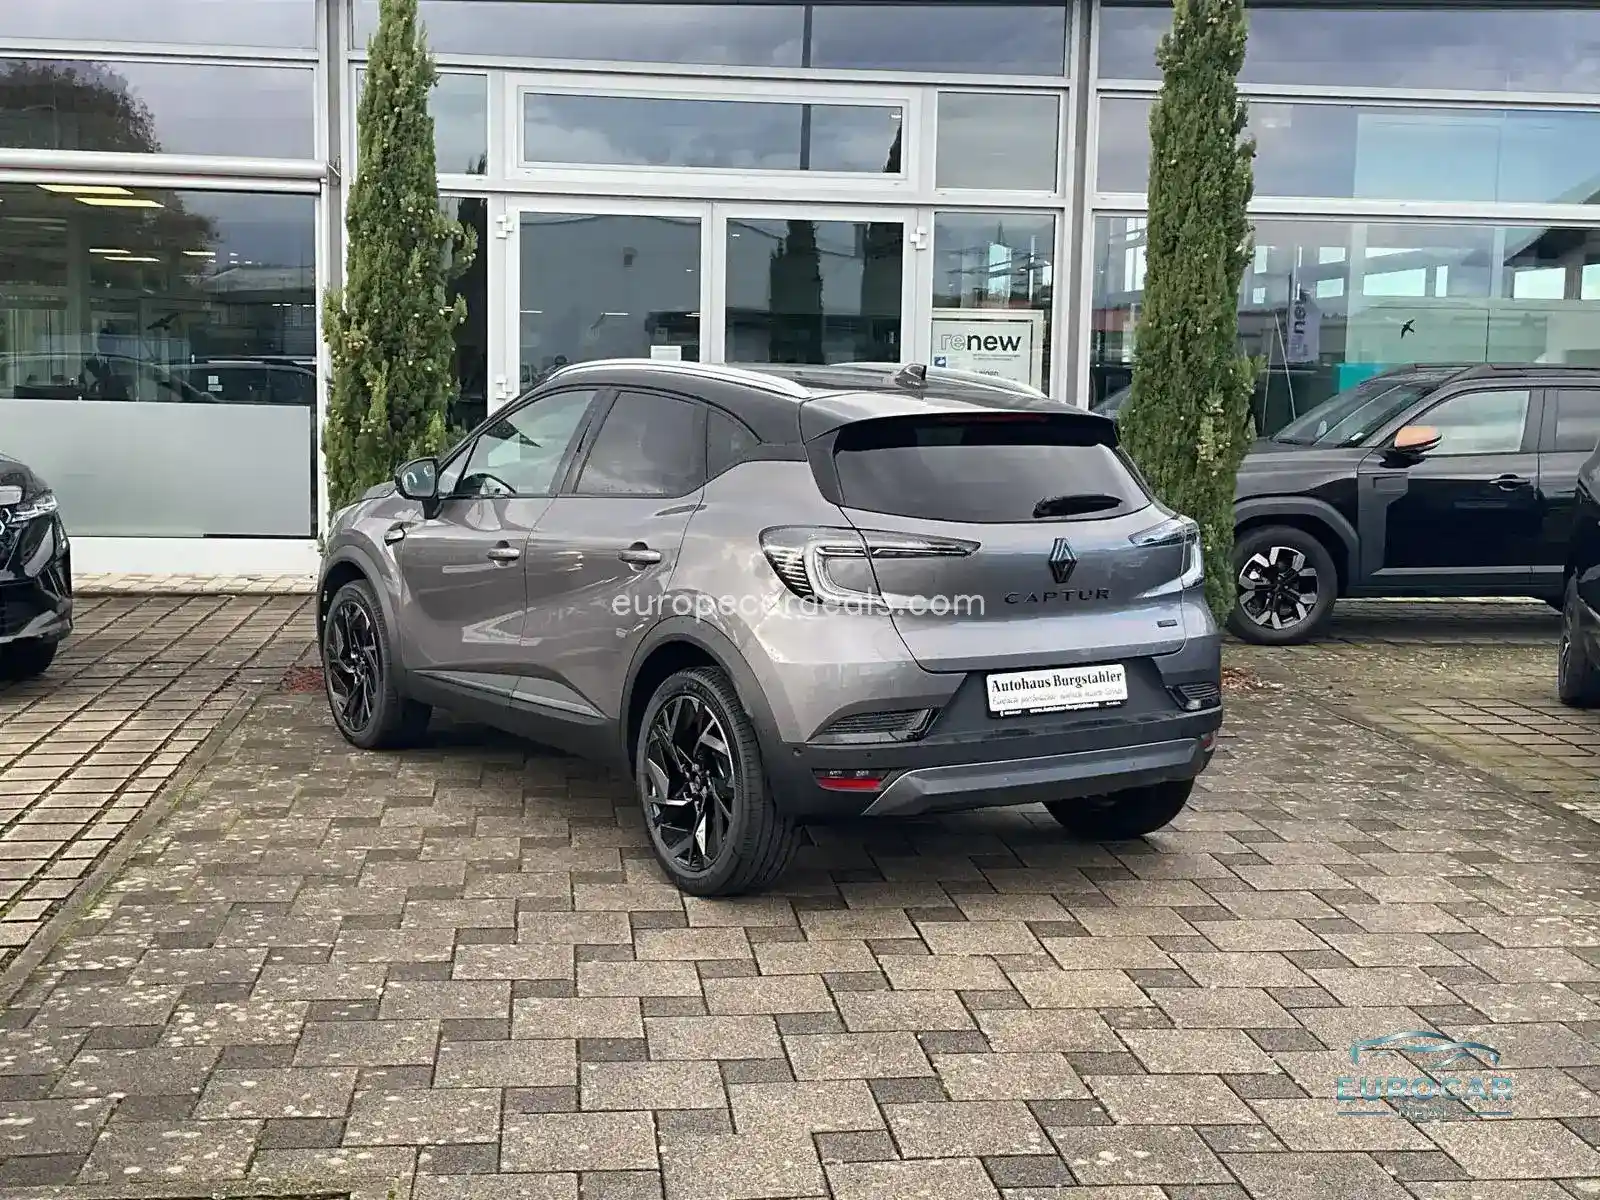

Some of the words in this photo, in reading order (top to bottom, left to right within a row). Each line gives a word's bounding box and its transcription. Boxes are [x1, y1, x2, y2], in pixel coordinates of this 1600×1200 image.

[940, 334, 1021, 351] renew
[1004, 588, 1111, 604] CAPTUR
[991, 677, 1051, 693] Autohaus
[1053, 671, 1122, 688] Burgstahler
